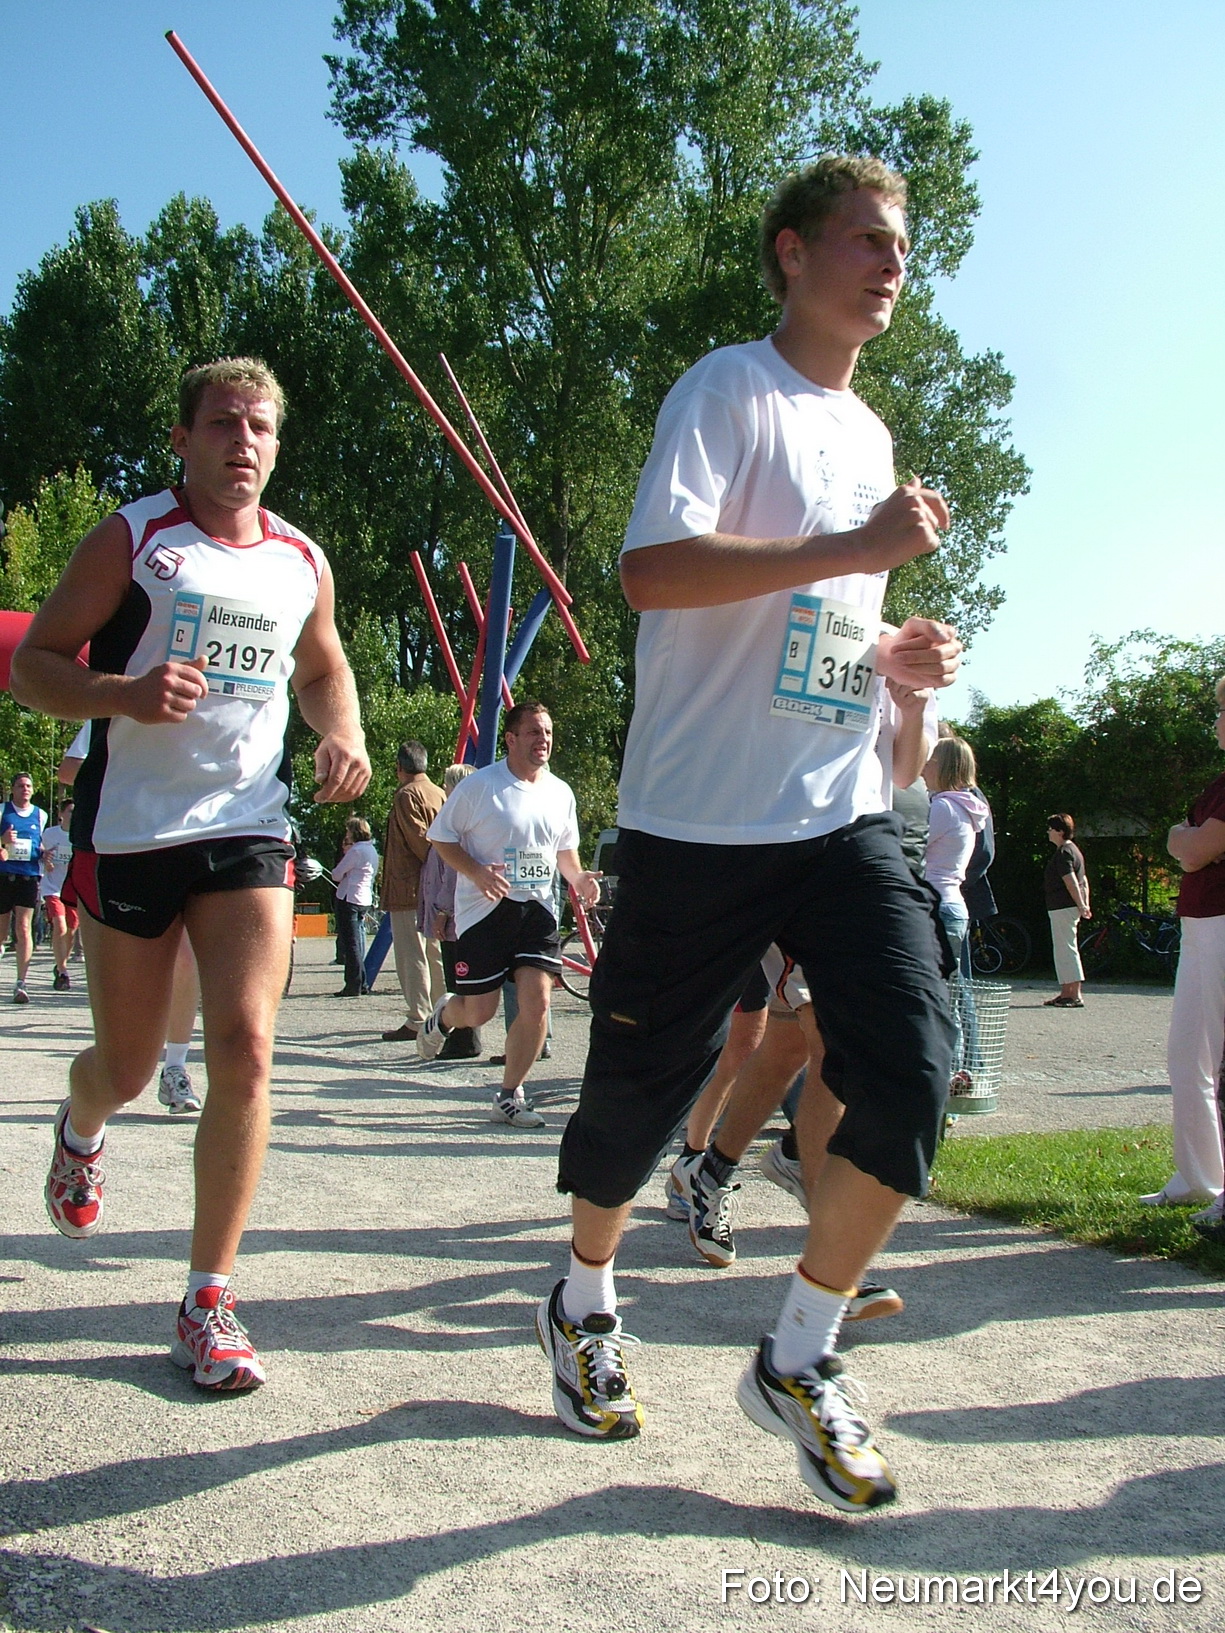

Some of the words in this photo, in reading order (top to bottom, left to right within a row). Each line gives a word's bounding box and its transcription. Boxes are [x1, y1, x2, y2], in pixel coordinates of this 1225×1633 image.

[208, 605, 277, 633] Alexander
[825, 611, 865, 642] Tobias
[176, 629, 184, 642] C
[206, 640, 275, 673] 2197
[789, 641, 799, 658] B
[818, 656, 873, 698] 3157
[236, 683, 275, 695] PFLEIDERER
[773, 697, 823, 716] BOCK
[519, 851, 543, 860] Thomas
[520, 866, 551, 879] 3454
